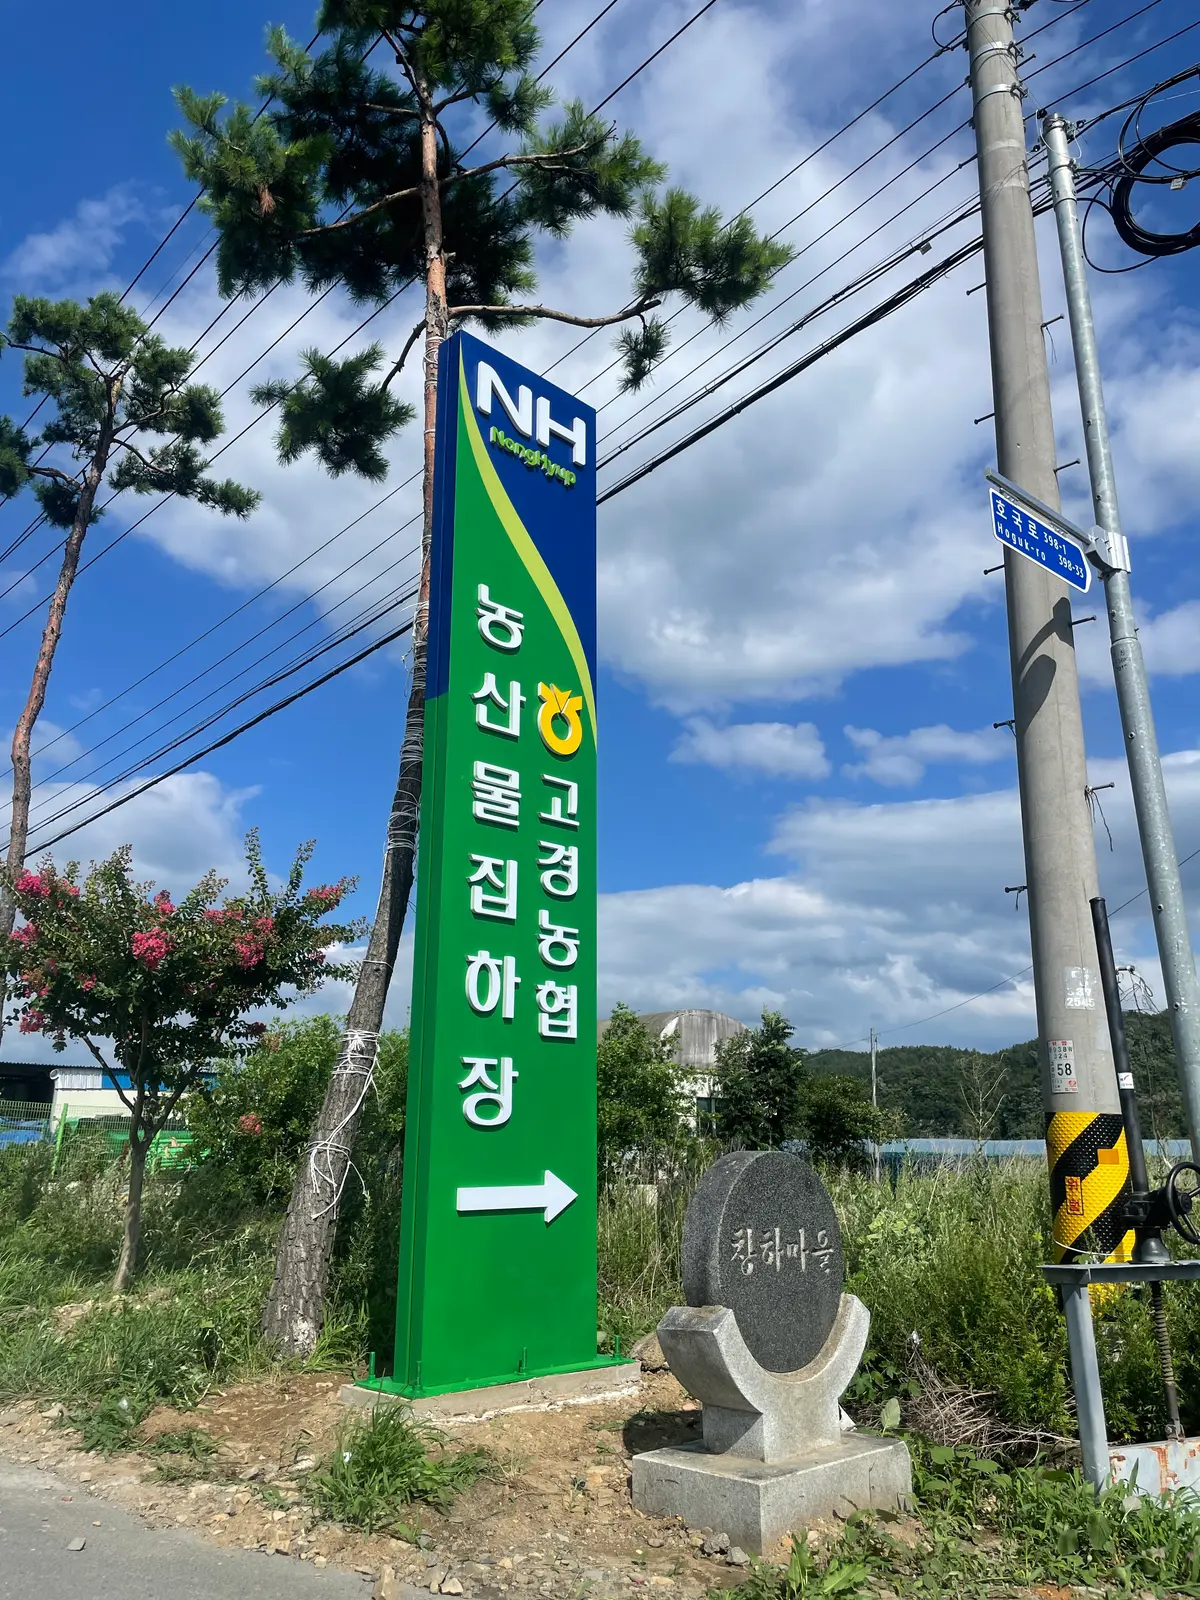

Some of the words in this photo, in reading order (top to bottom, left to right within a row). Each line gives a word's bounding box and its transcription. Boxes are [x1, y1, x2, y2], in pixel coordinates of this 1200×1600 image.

[477, 361, 586, 467] NH
[490, 426, 576, 486] NongHyup
[996, 499, 1039, 540] 호국로
[1043, 531, 1067, 555] 398-1
[997, 521, 1046, 561] Hoguk-ro
[1058, 554, 1084, 579] 398-33
[458, 583, 526, 1128] 농산물집하장
[536, 773, 580, 1040] 고경농협
[1057, 1062, 1072, 1077] 58
